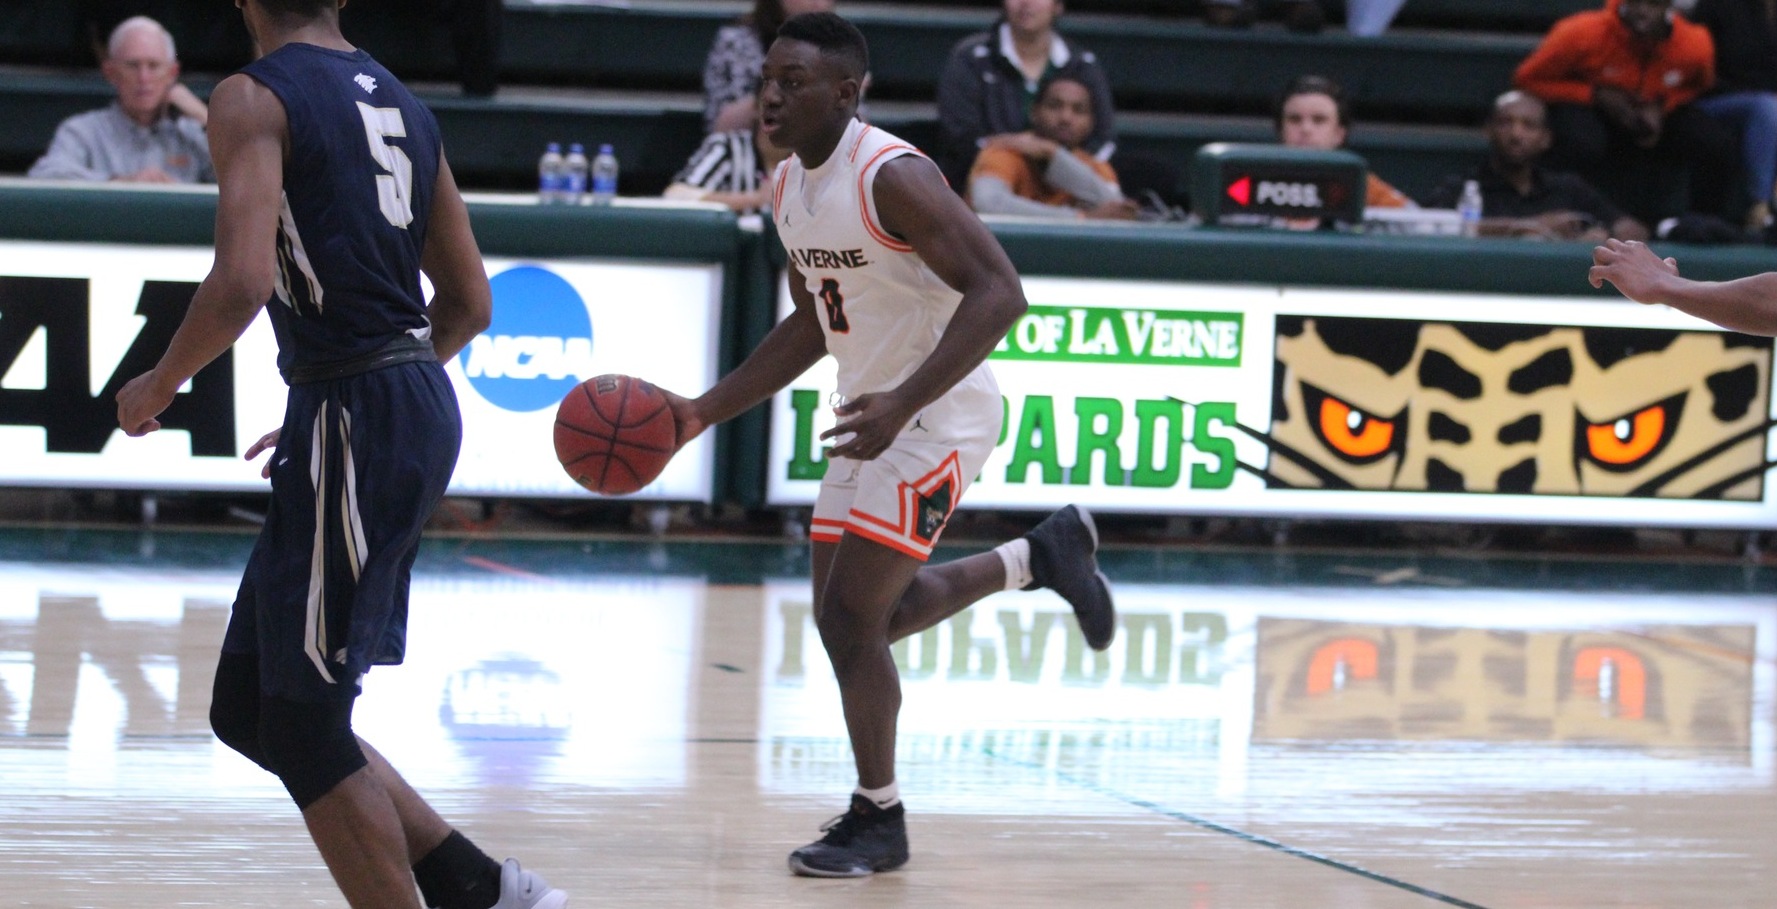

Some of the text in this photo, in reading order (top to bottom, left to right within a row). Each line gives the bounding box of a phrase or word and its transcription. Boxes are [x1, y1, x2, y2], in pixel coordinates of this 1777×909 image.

[355, 101, 414, 230] 5
[1256, 180, 1323, 207] POSS.
[798, 248, 868, 269] VERNE
[819, 277, 850, 334] 0
[466, 334, 598, 380] NCAA
[1015, 314, 1065, 353] OF
[1068, 309, 1119, 355] LA
[1121, 311, 1239, 359] VERNE
[787, 389, 1237, 489] LARDS
